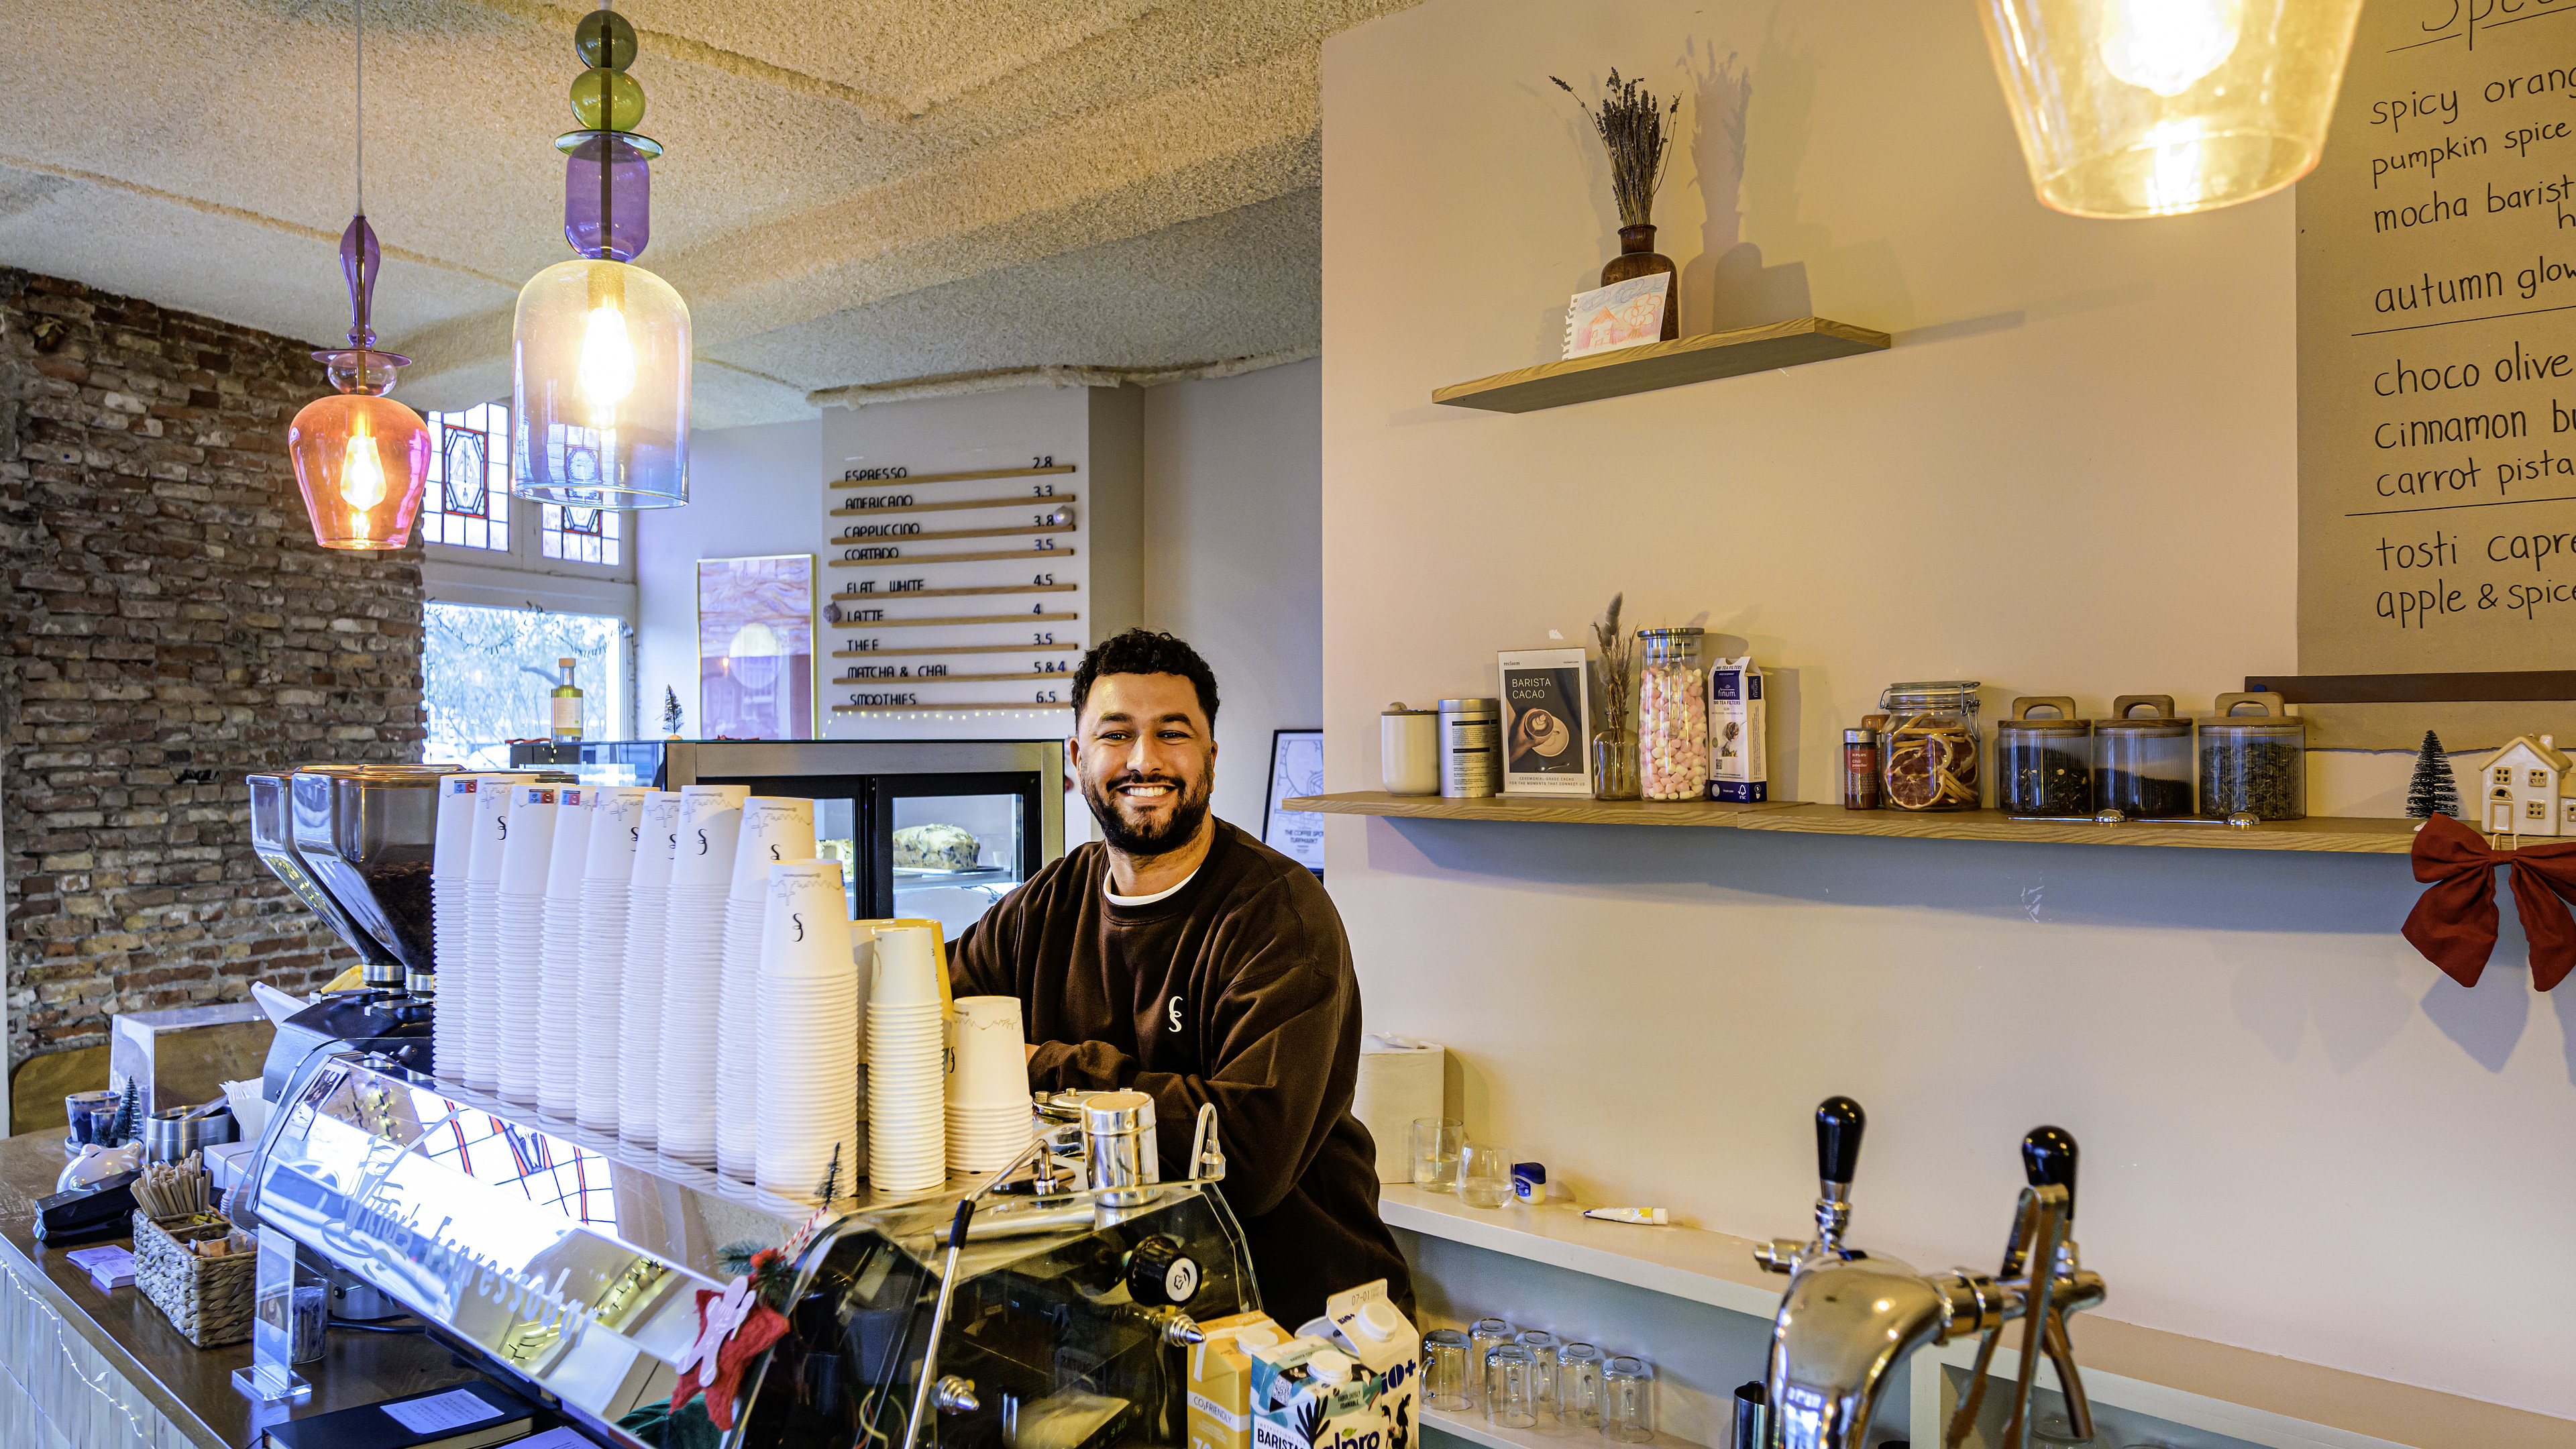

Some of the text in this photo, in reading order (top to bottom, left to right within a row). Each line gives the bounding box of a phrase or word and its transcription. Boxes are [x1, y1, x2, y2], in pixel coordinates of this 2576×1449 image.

[2369, 90, 2459, 133] spicy
[2372, 121, 2573, 189] pumpkin spice
[2374, 191, 2468, 233] mocha
[2375, 272, 2503, 313] autumn
[2374, 341, 2573, 396] choco olive
[2374, 410, 2527, 449] cinnamon
[845, 456, 1053, 482] ESPRESSO 2.8
[2377, 457, 2481, 497] carrot
[845, 485, 1053, 510] AMERICANO 3.3
[844, 515, 1055, 538] CAPPUCCINO 3.8
[844, 539, 1054, 561] CORTADO 3.5
[2375, 531, 2576, 572] tosti capr
[847, 574, 1053, 594] FLAT WHITE 4.5
[847, 604, 1041, 623] LATTE 4
[2376, 578, 2576, 629] apple & spic
[847, 633, 1053, 651] THEE 3.5
[847, 660, 1065, 679] MATCHA & CHAI 5 & 4
[1511, 678, 1552, 688] BARISTA
[1512, 690, 1545, 699] CACAO
[1718, 689, 1736, 697] finum
[850, 691, 1057, 706] SMOOTHIES 6.5
[1352, 1290, 1370, 1306] 07-01
[1322, 1430, 1381, 1449] lpro
